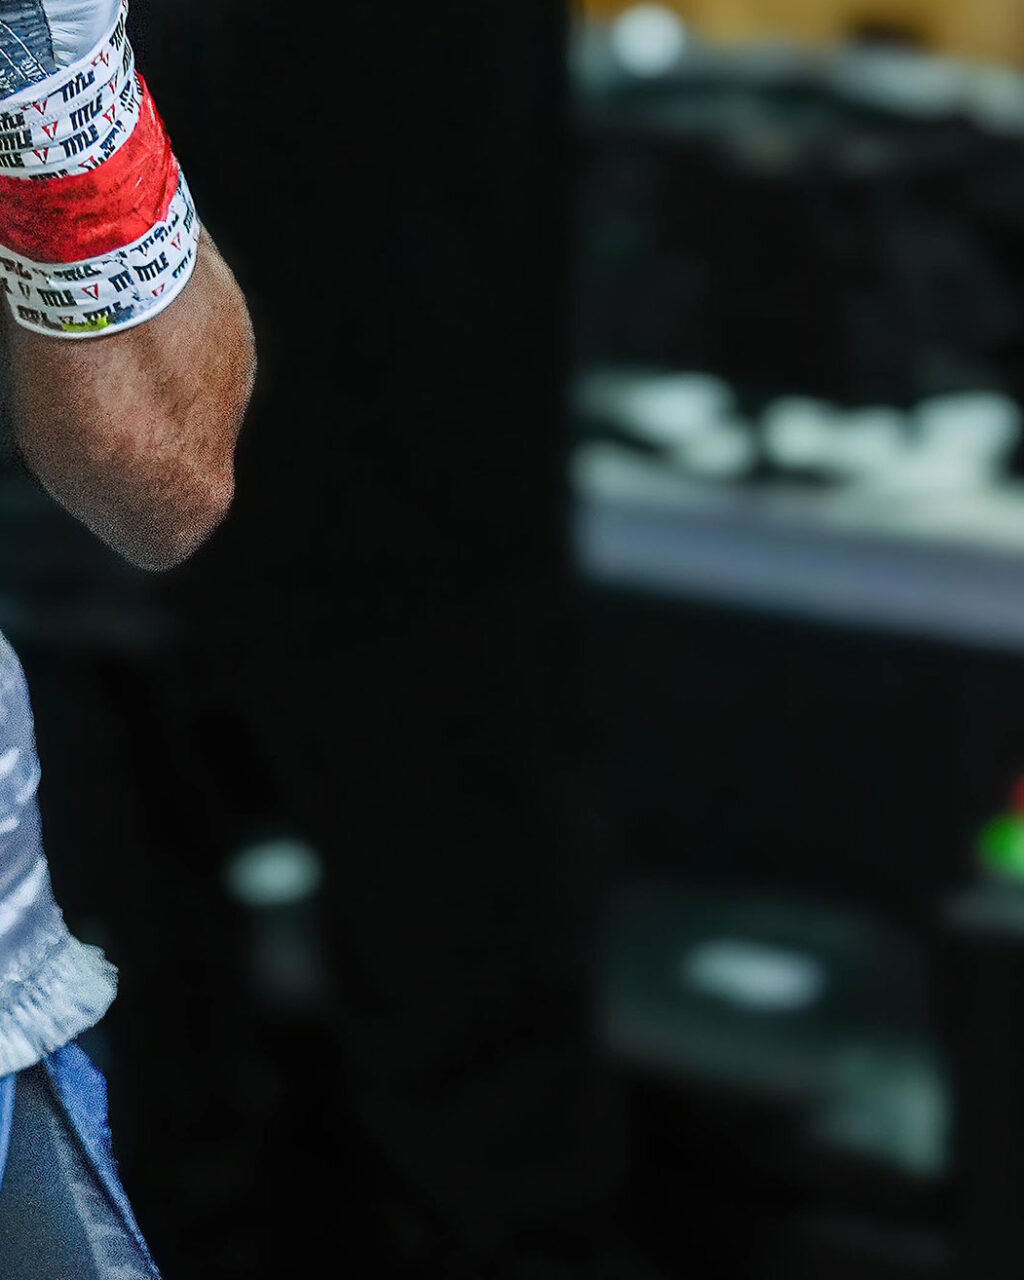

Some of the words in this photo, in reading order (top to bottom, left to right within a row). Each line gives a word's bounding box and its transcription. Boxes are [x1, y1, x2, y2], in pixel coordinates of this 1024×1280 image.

[68, 93, 104, 131] TITLE
[59, 124, 100, 158] TITLE
[132, 251, 170, 282] TITLE
